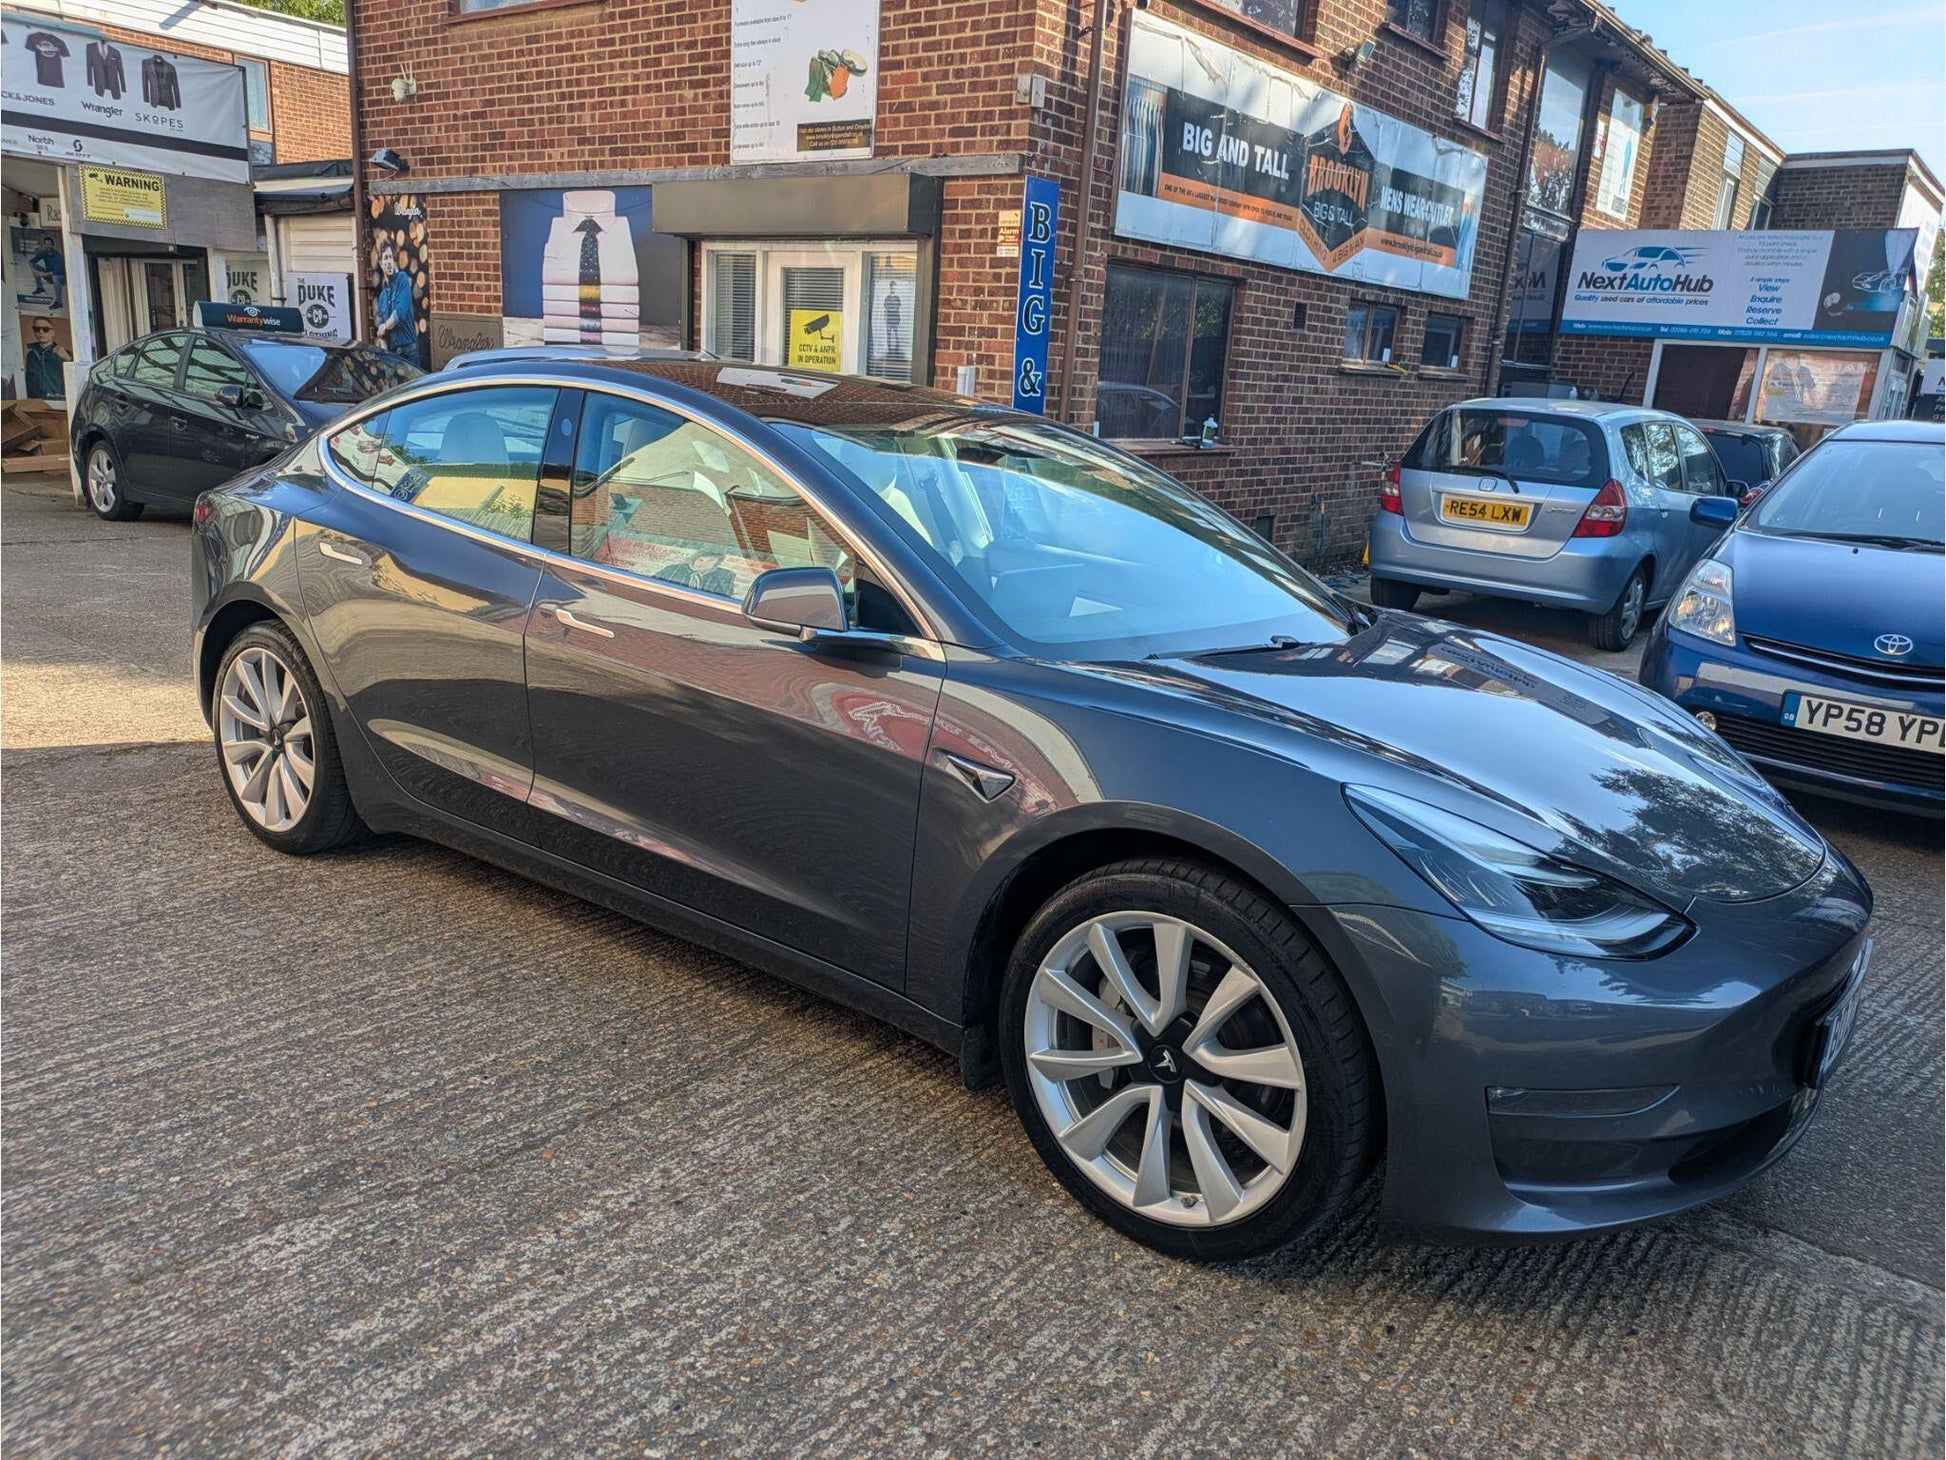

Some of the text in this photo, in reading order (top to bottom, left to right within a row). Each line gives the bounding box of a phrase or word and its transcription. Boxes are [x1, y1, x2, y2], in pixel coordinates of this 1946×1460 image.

[1, 90, 55, 106] CK&JONES
[81, 100, 124, 118] Wrangler
[135, 112, 184, 129] SKOPES
[28, 134, 54, 145] North
[1183, 121, 1290, 181] BIG AND TALL
[104, 173, 160, 192] WARNING
[1307, 154, 1369, 213] BROOKLYN
[1380, 185, 1403, 214] MENS
[47, 204, 61, 222] Rae
[999, 227, 1019, 235] Alarm
[1577, 271, 1714, 293] NextAutoHub
[1758, 283, 1781, 292] View
[298, 284, 336, 309] DUKE
[1574, 294, 1600, 303] Quality
[1600, 294, 1618, 303] used
[1646, 296, 1684, 305] affordable
[1684, 297, 1709, 306] prices
[1750, 294, 1782, 304] Enquire
[1745, 305, 1782, 315] Reserve
[226, 314, 281, 327] Warrantywise
[1746, 316, 1779, 326] Collect
[437, 323, 495, 350] Wrangler
[798, 343, 813, 353] CCTV
[819, 345, 836, 354] ANPR
[797, 354, 837, 365] IN OPERATION
[1449, 500, 1523, 522] RE54 LXW
[1783, 712, 1795, 721] GB
[1806, 699, 1887, 737] YP58
